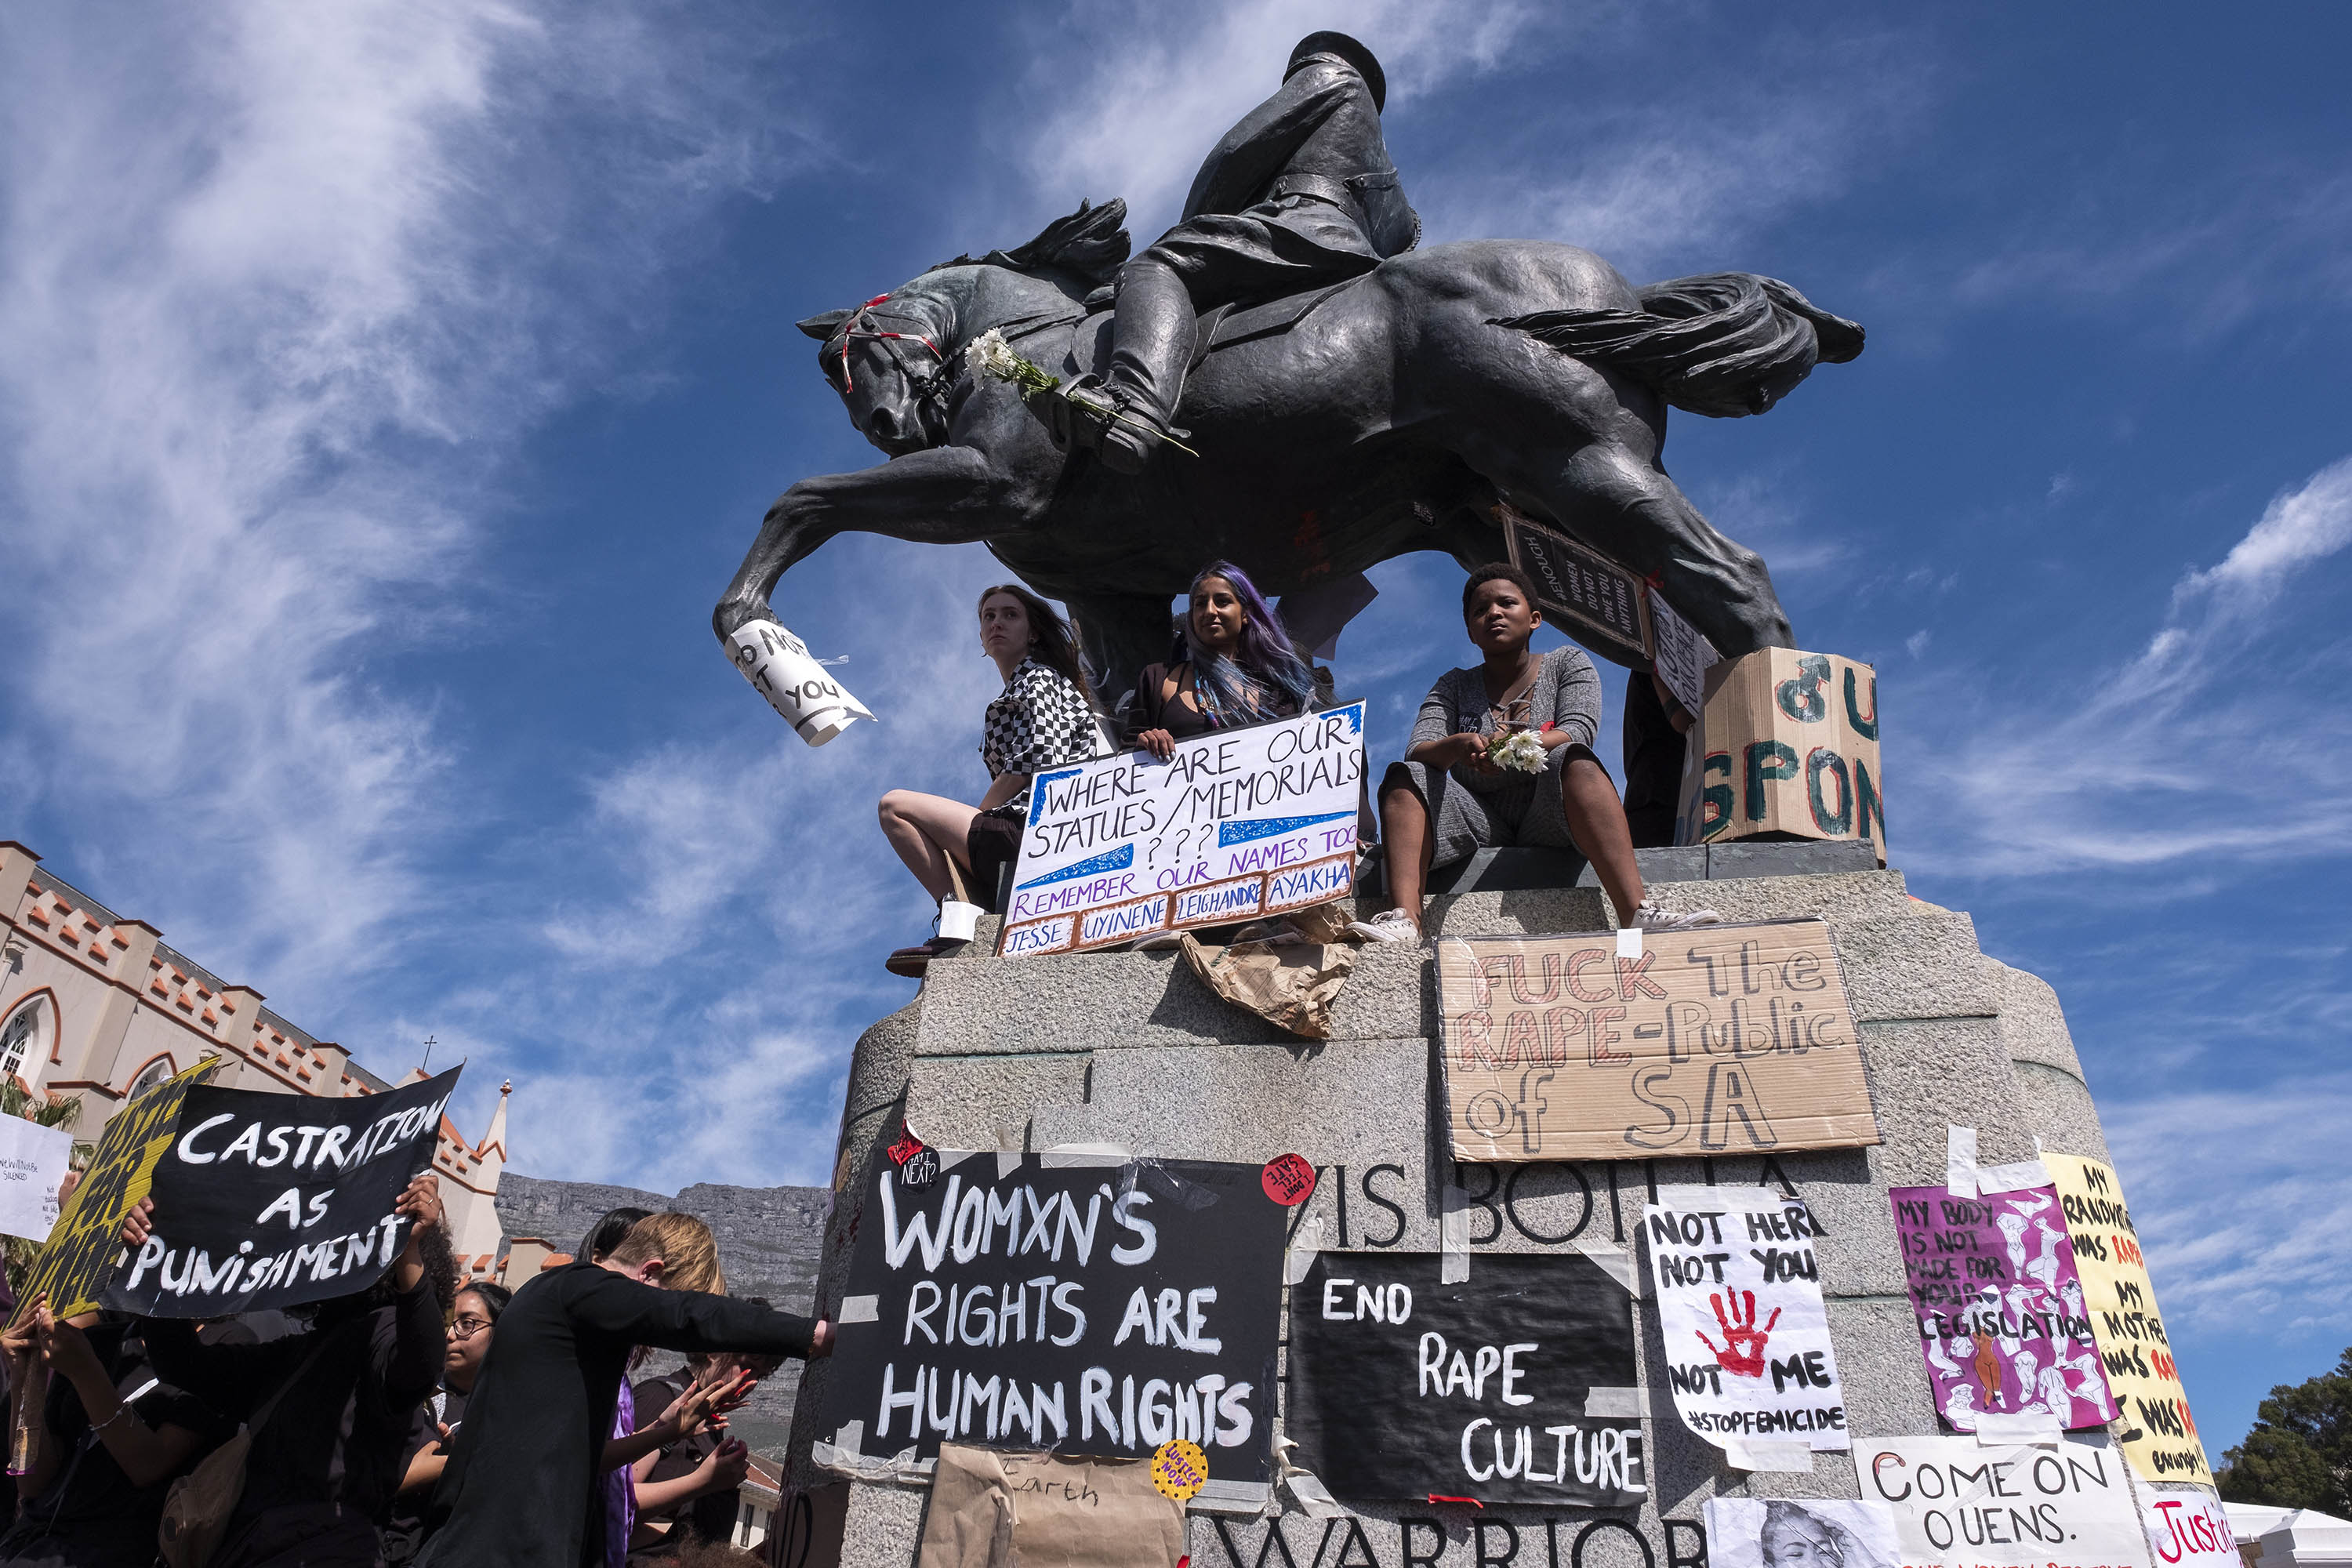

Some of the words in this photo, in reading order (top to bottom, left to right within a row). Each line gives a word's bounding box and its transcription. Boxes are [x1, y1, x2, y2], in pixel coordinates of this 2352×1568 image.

[1524, 536, 1568, 601] #ENOUGH
[1566, 560, 1583, 603] WOMEN
[1582, 568, 1596, 593] NOT
[1599, 573, 1610, 597] YOU
[1587, 597, 1599, 611] DO
[1603, 600, 1616, 622] OWE
[1613, 579, 1634, 635] ANYTHING
[785, 681, 840, 709] YOU
[1045, 762, 1149, 815] WHERE
[1164, 740, 1241, 788] ARE
[1267, 717, 1352, 763] OUR
[1012, 873, 1140, 923] REMEMBER
[1156, 861, 1212, 890] OUR
[1228, 837, 1308, 877] NAMES
[1320, 824, 1357, 848] TOO
[1007, 924, 1063, 953] JESSE
[1085, 898, 1166, 939] UYINENE
[1177, 877, 1263, 921] LEIGHANDRE
[1270, 863, 1352, 903] AYAKHA
[1469, 947, 1668, 1010] FUCK
[1687, 939, 1826, 997] The
[1465, 1067, 1555, 1155] of
[1624, 1062, 1778, 1151] SA
[177, 1092, 452, 1169] CASTRATION
[902, 1163, 936, 1185] NEXT?
[1266, 1156, 1299, 1185] SAFE
[1278, 1169, 1303, 1189] FEEL
[2082, 1163, 2110, 1196] MY
[256, 1187, 335, 1229] AS
[880, 1170, 1157, 1272] WOMXN'S
[1650, 1210, 1726, 1248] NOT
[1745, 1206, 1809, 1243] HER
[1897, 1200, 1929, 1229] MY
[1940, 1200, 1993, 1229] BODY
[1902, 1231, 1927, 1257] IS
[1933, 1229, 1979, 1254] NOT
[2071, 1233, 2108, 1262] WAS
[1659, 1253, 1730, 1288] NOT
[1749, 1247, 1820, 1284] YOU
[1904, 1257, 1960, 1280] MADE
[1965, 1256, 2006, 1279] FOR
[903, 1275, 1088, 1347] RIGHTS
[1113, 1286, 1223, 1356] ARE
[1323, 1278, 1413, 1325] END
[1910, 1282, 1984, 1309] YOUR
[2114, 1279, 2143, 1311] MY
[1918, 1310, 2094, 1342] LEGISLATION
[1418, 1331, 1539, 1406] RAPE
[1668, 1363, 1723, 1397] NOT
[1769, 1351, 1834, 1395] ME
[2101, 1344, 2151, 1379] WAS
[877, 1363, 1069, 1446] HUMAN
[1080, 1366, 1255, 1450] RIGHTS
[1688, 1406, 1847, 1436] #STOPFEMICIDE
[2136, 1396, 2184, 1439] WAS
[1161, 1461, 1185, 1487] NOW
[1165, 1446, 1203, 1486] JUSTICE
[1461, 1417, 1647, 1493] CULTURE
[1871, 1450, 2023, 1503] COME
[2036, 1449, 2108, 1496] ON
